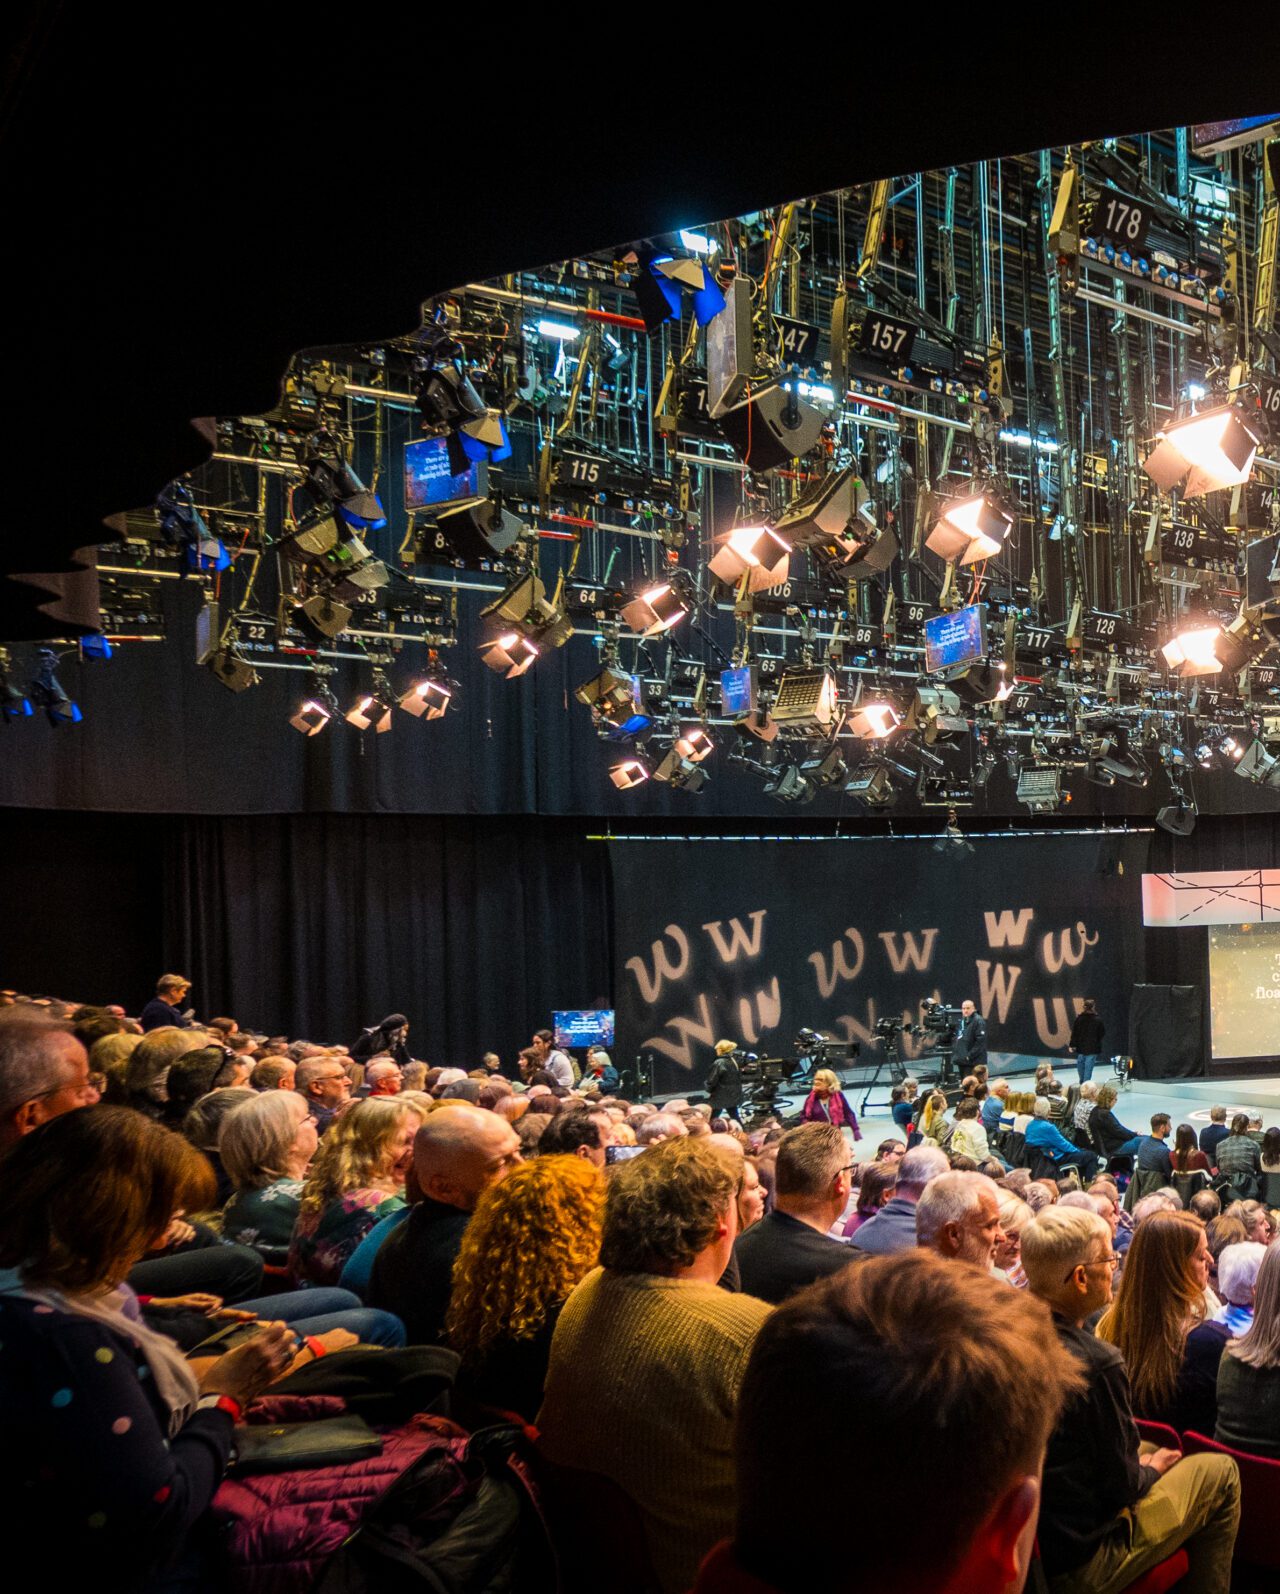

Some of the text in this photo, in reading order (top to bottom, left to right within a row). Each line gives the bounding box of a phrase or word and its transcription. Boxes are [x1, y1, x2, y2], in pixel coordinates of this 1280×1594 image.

[1106, 200, 1141, 239] 178
[872, 321, 907, 353] 157
[571, 459, 599, 483] 115
[435, 533, 445, 548] 8
[1174, 529, 1195, 549] 138
[579, 590, 596, 604] 64
[768, 582, 791, 598] 106
[909, 606, 923, 621] 96
[249, 626, 265, 639] 22
[1096, 618, 1115, 635] 128
[857, 629, 871, 642] 86
[1027, 632, 1050, 648] 117
[684, 666, 698, 677] 44
[762, 660, 776, 672] 65
[1259, 671, 1273, 682] 109
[649, 685, 661, 696] 33
[1017, 696, 1029, 708] 87
[1209, 694, 1218, 705] 78
[984, 908, 1034, 947] W
[703, 910, 767, 963] W
[878, 928, 939, 972] W
[976, 960, 1021, 1024] W
